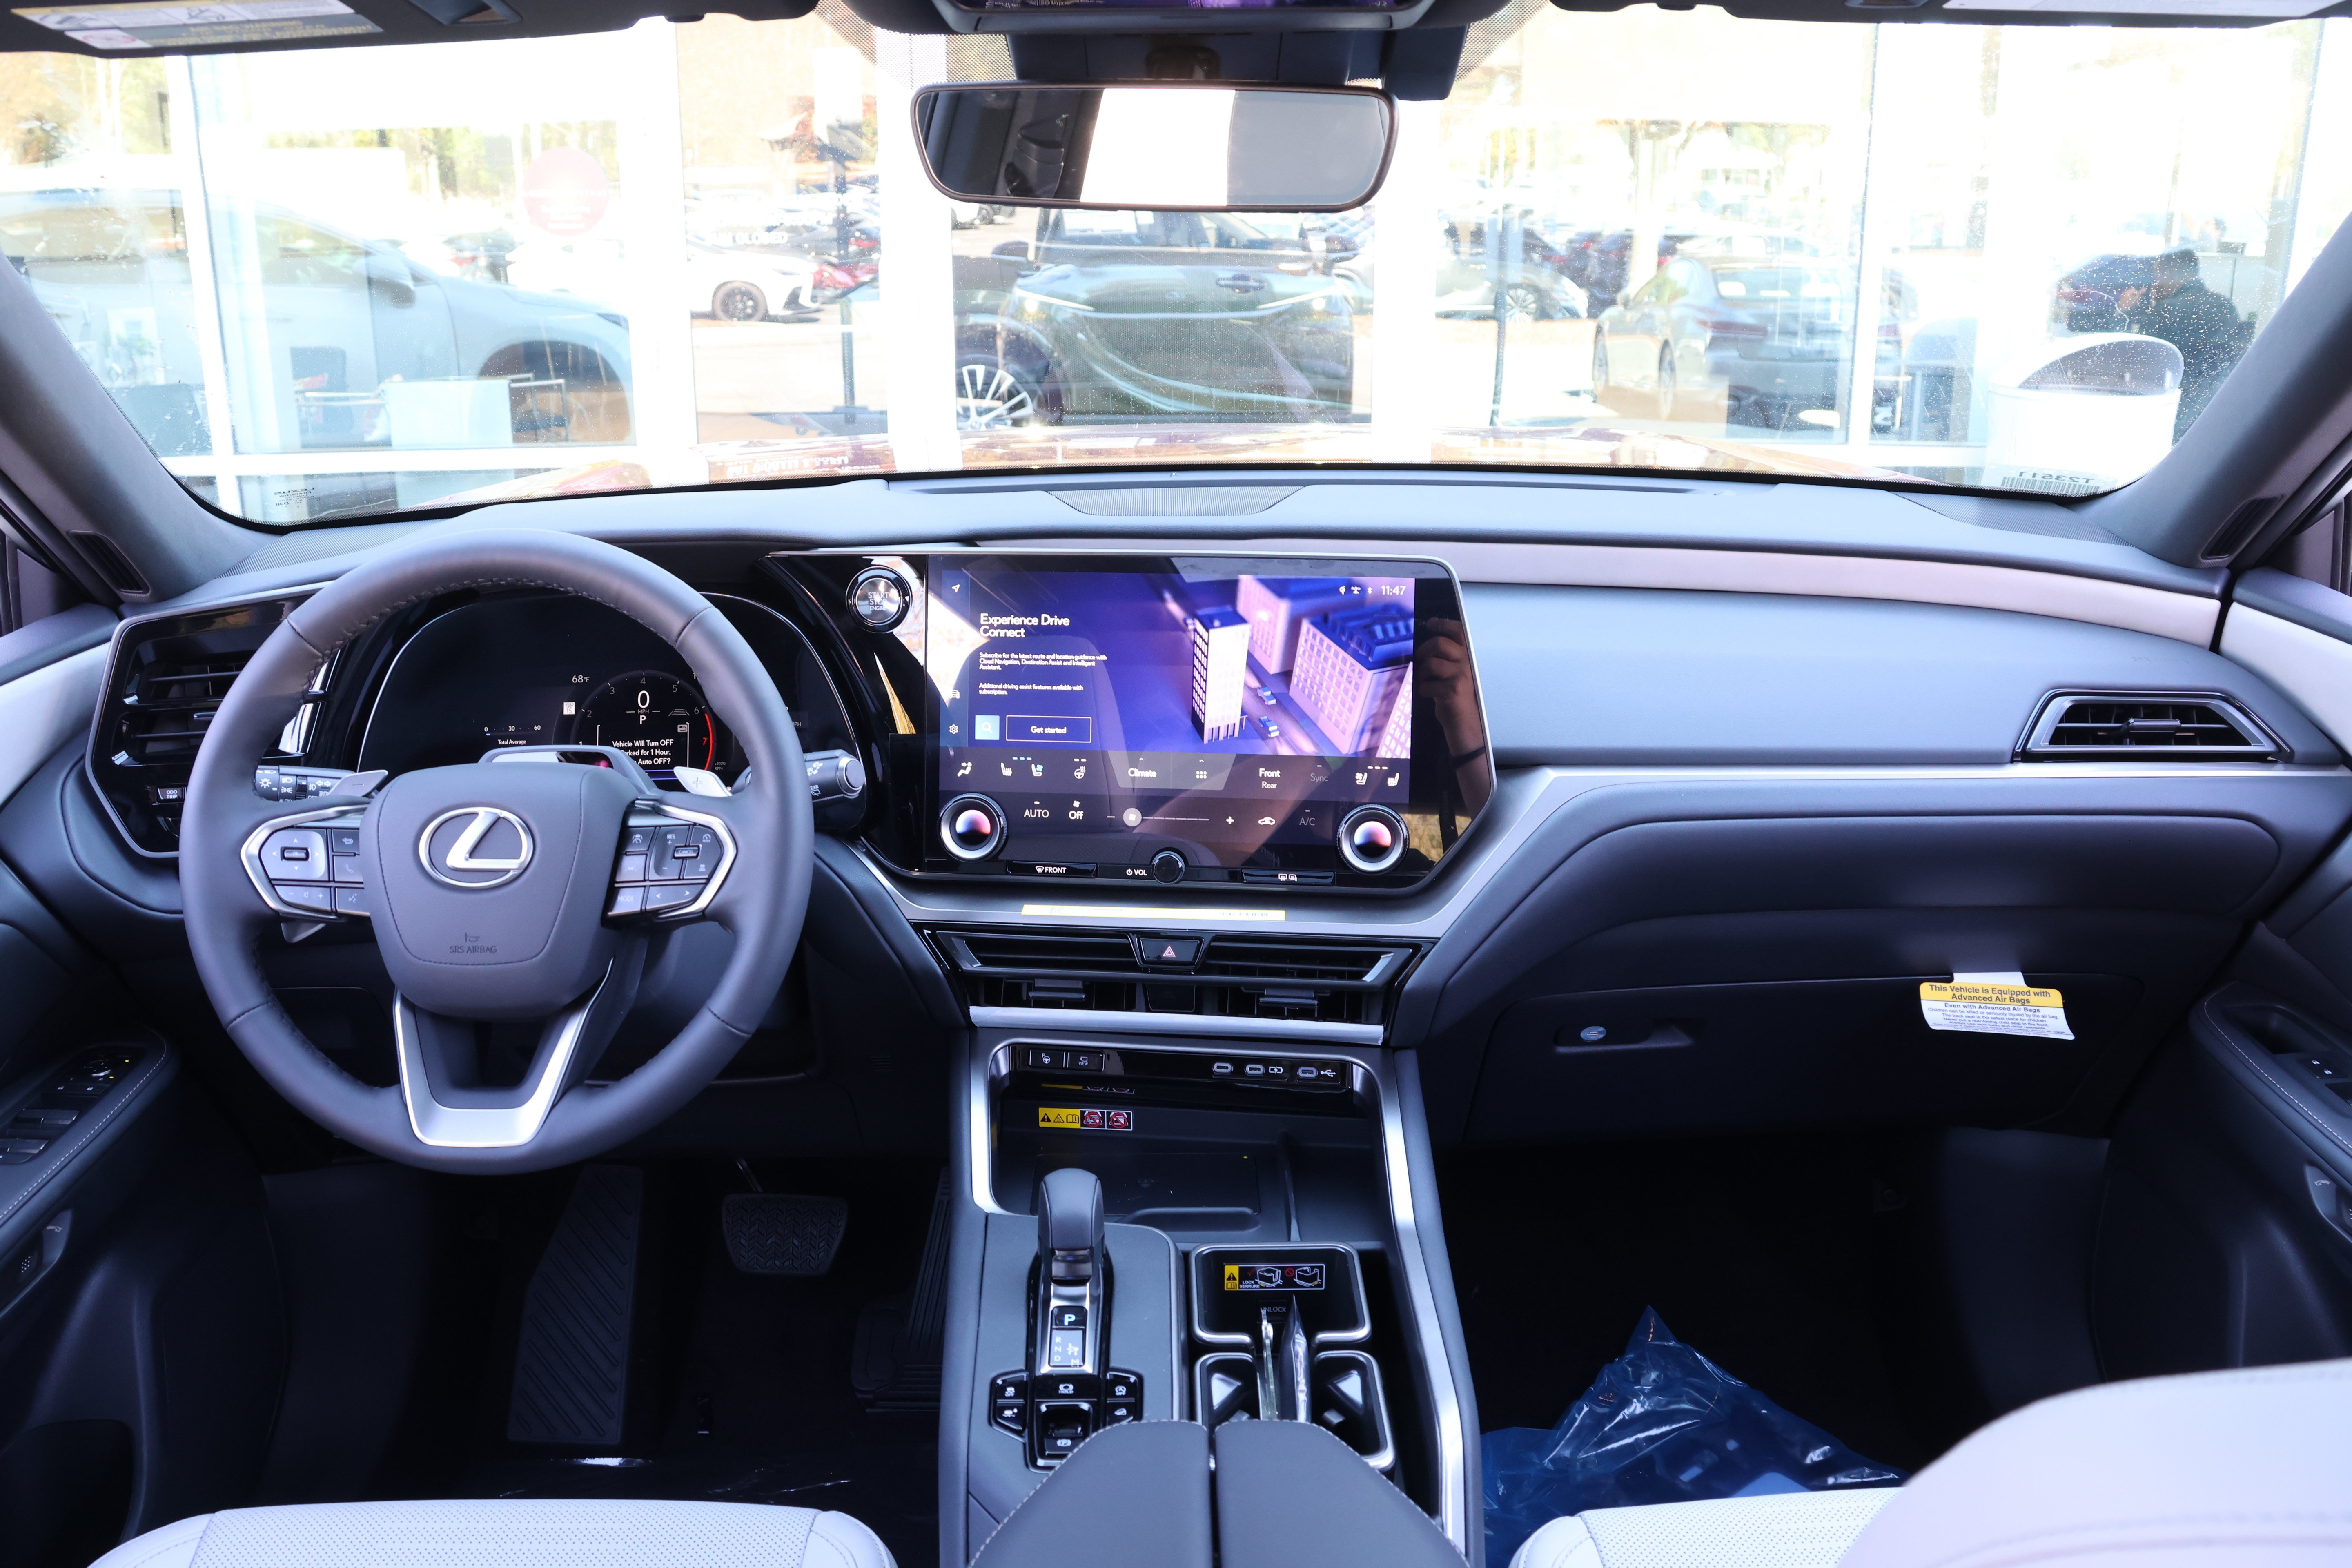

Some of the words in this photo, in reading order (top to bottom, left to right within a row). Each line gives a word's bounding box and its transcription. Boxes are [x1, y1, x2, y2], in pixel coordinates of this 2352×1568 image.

[1381, 585, 1407, 595] 11:47
[980, 613, 1039, 627] Experience
[1041, 614, 1070, 626] Drive
[980, 625, 1025, 638] Connect
[572, 675, 590, 683] 68°F
[672, 684, 678, 693] 5
[637, 690, 650, 708] 0
[639, 715, 646, 724] P
[1030, 726, 1043, 734] Get
[1044, 726, 1067, 734] started
[702, 737, 708, 746] 7
[1128, 768, 1157, 778] Climate
[1259, 768, 1281, 778] Front
[1310, 773, 1329, 783] Sync
[1024, 809, 1049, 818] AUTO
[1069, 811, 1084, 820] Off
[1299, 817, 1316, 826] A/C
[1951, 993, 1993, 1002] Advanced
[1992, 988, 2031, 999] Equipped
[1064, 1314, 1076, 1326] P
